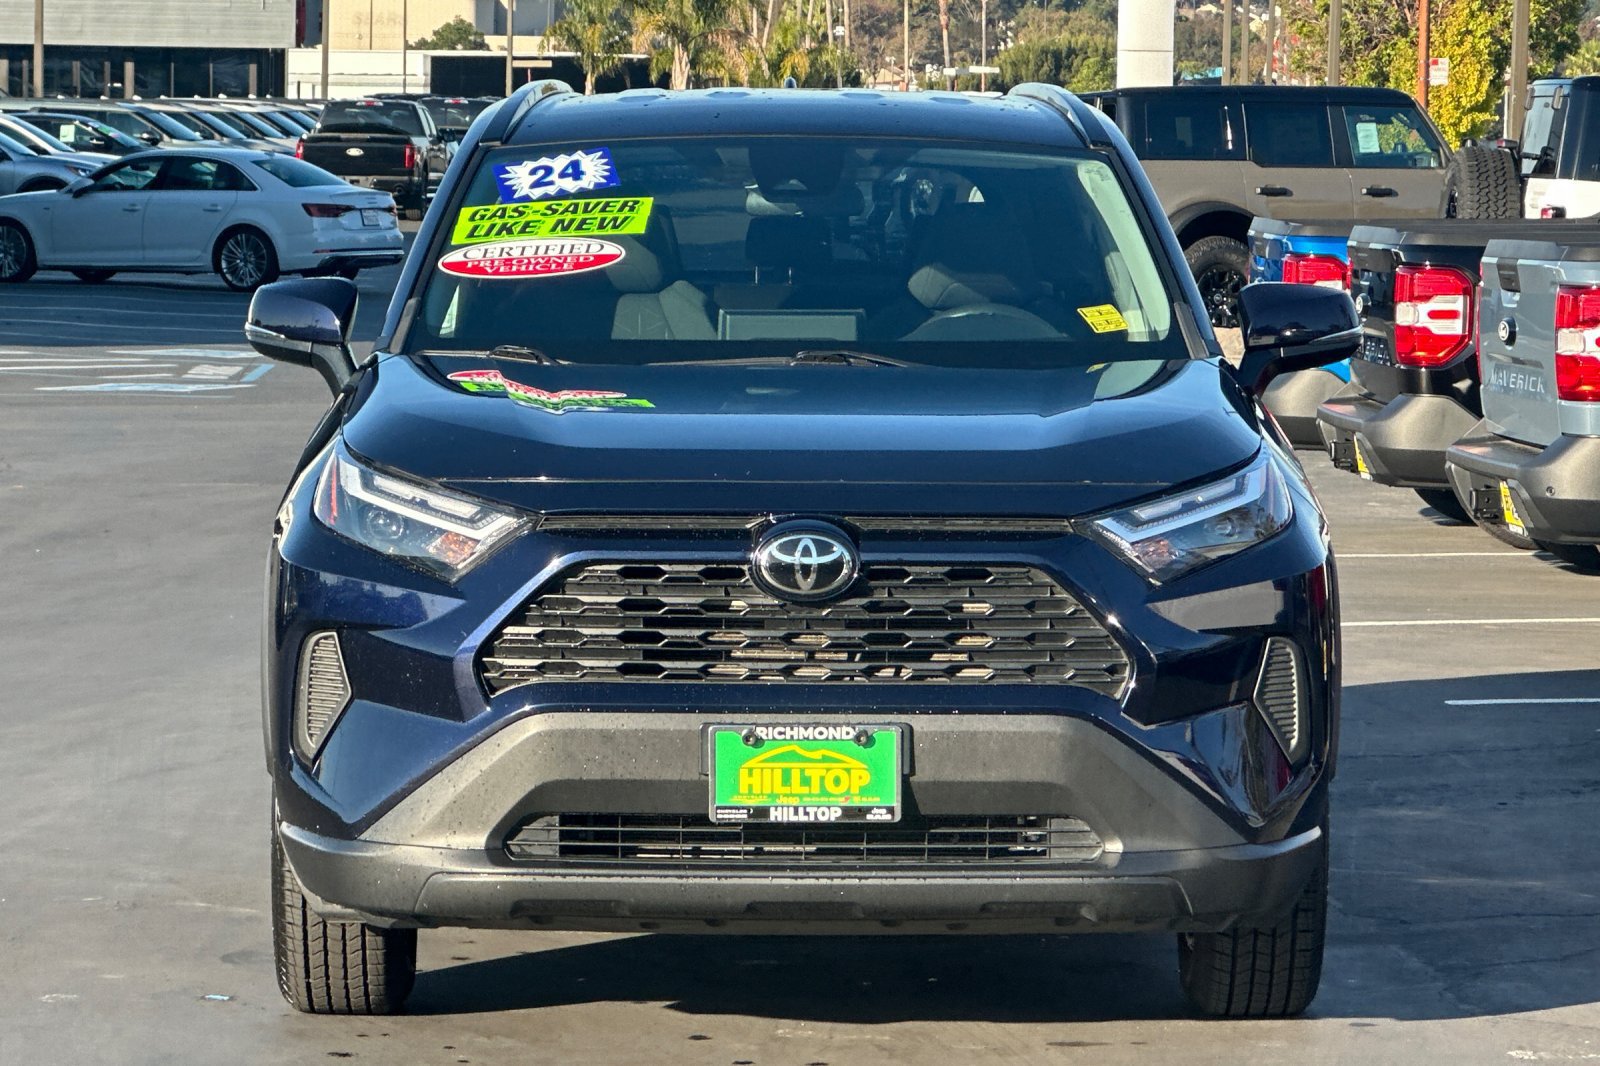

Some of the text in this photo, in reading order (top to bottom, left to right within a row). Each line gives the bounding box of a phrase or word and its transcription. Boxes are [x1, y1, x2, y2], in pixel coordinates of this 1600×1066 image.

[528, 159, 587, 190] 24
[467, 199, 643, 223] GAS-SAVER
[464, 215, 635, 240] LIKE NEW
[462, 242, 605, 260] CERTIFIED
[466, 254, 595, 269] PRE-OWNED
[484, 261, 575, 274] VEHICLE
[756, 726, 855, 740] RICHMOND
[739, 767, 871, 794] HILLTOP
[769, 806, 842, 821] HILLTOP
